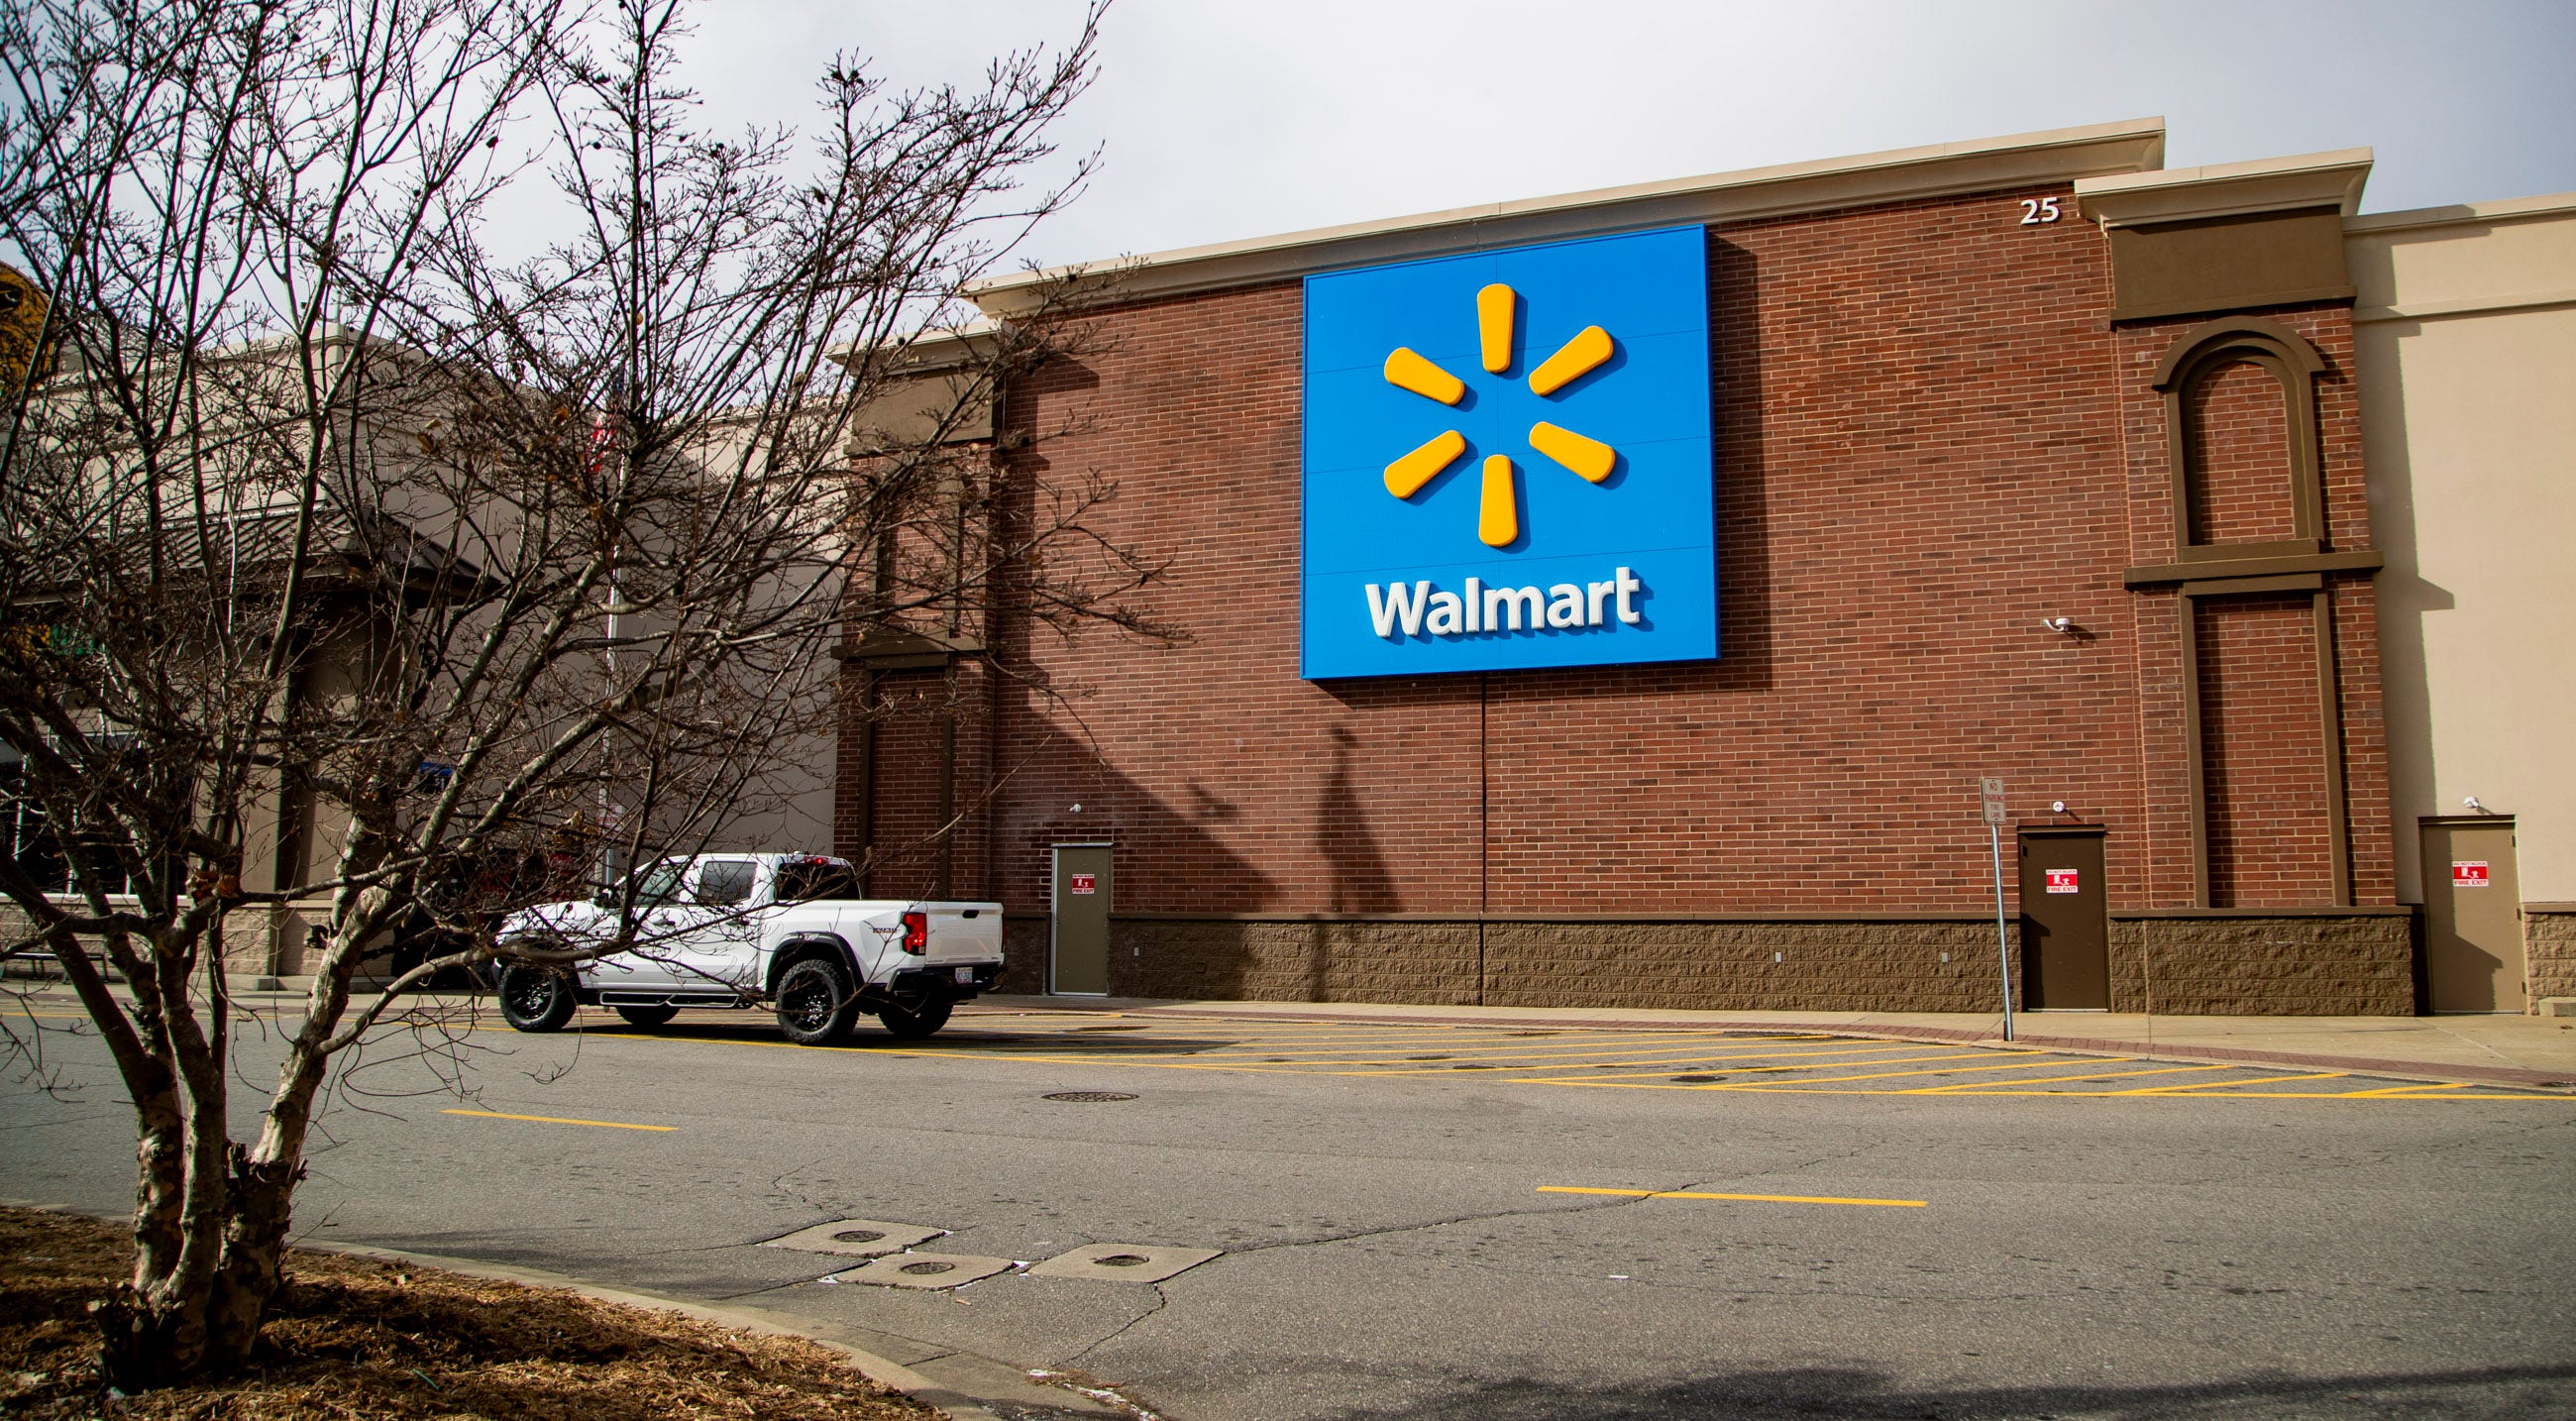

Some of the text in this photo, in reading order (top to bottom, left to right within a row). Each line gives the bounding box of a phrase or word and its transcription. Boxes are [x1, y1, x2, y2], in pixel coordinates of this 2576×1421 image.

[2020, 197, 2059, 224] 25
[1365, 567, 1640, 638] Walmart
[1989, 782, 1997, 791] NO
